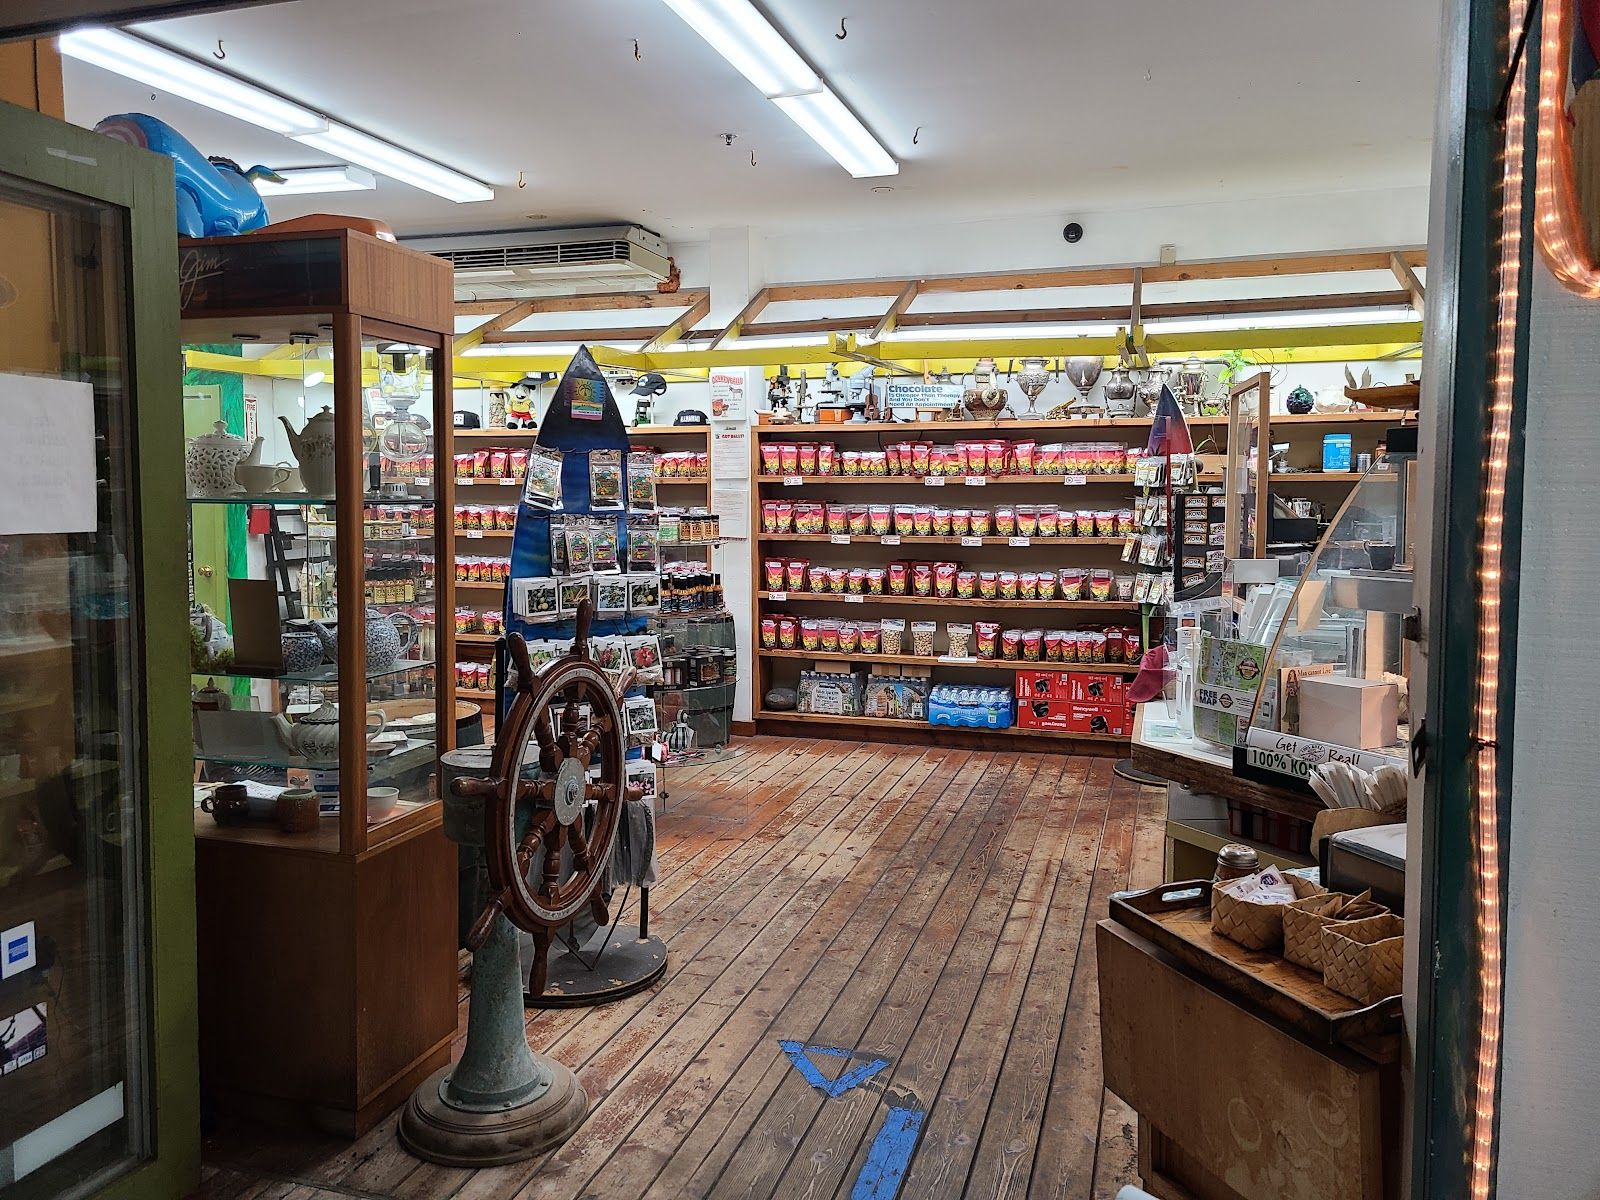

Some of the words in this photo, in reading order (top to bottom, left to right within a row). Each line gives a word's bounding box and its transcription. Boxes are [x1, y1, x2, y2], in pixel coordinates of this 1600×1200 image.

[180, 250, 229, 311] Jim
[889, 385, 943, 393] Chocolate
[1199, 689, 1217, 699] FREE
[1199, 697, 1217, 706] MAP
[1275, 737, 1297, 753] Get
[1252, 750, 1286, 770] 100%
[1291, 759, 1320, 777] KON
